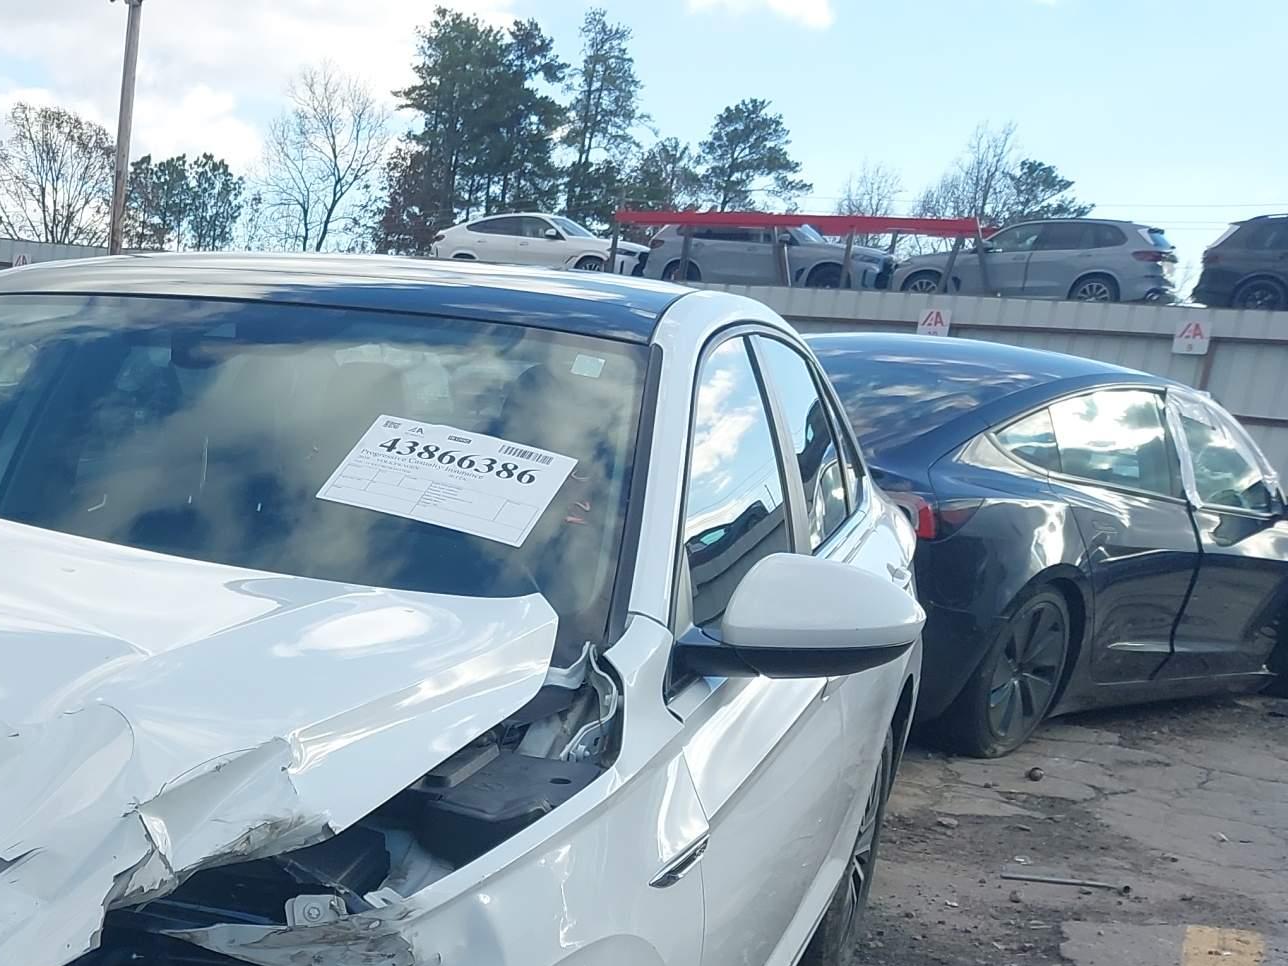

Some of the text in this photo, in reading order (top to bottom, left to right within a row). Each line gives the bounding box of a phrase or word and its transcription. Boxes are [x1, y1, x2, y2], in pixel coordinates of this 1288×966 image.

[360, 448, 407, 462] Progressive
[408, 456, 442, 471] Casualty
[444, 464, 485, 480] Insurance
[378, 437, 542, 485] 43866386
